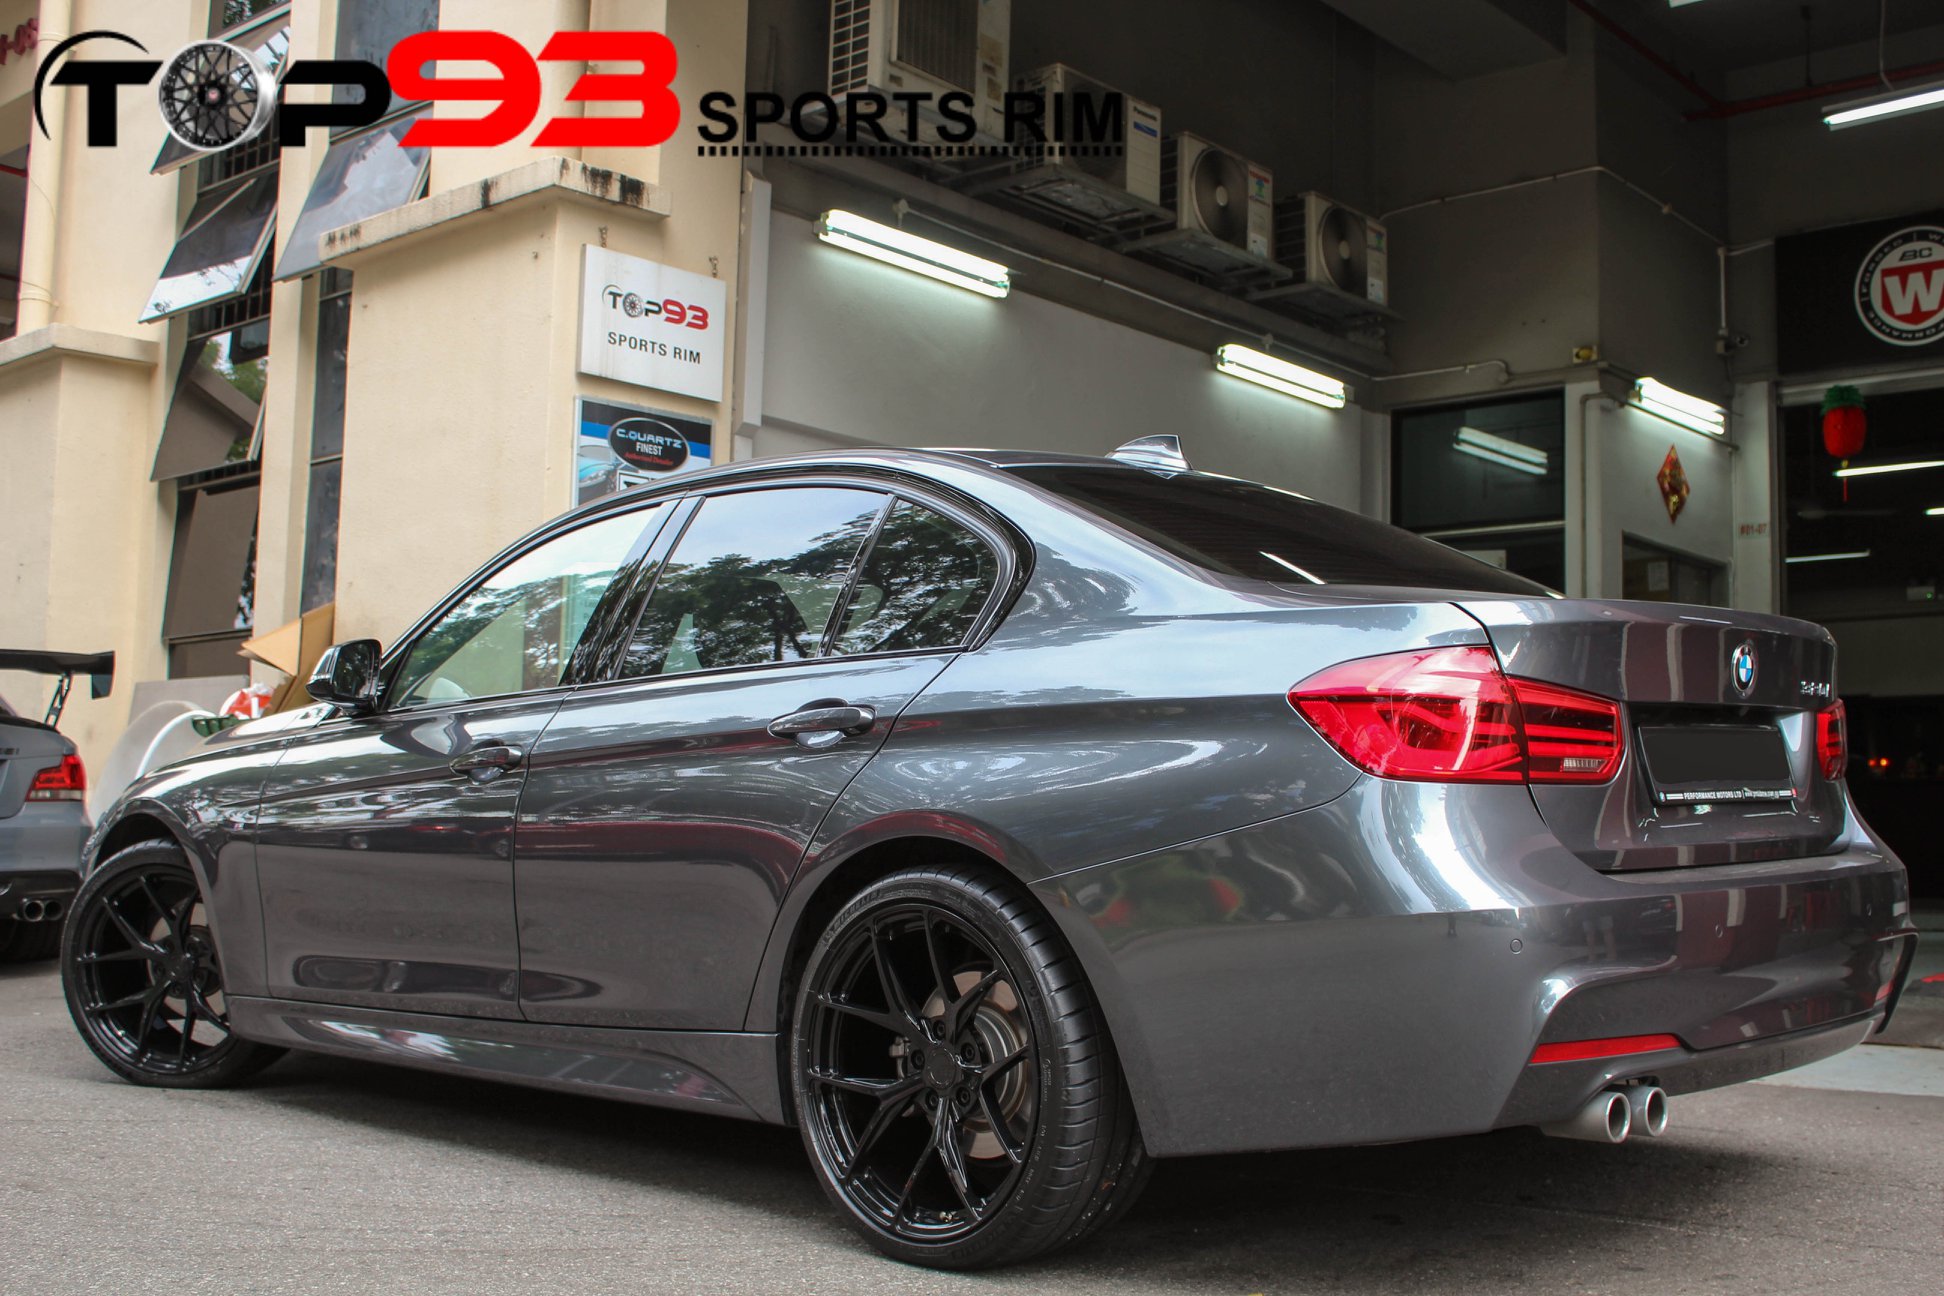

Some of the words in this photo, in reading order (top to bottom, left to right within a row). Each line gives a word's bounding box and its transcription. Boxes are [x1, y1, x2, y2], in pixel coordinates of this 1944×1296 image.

[607, 331, 667, 357] SPORTS
[673, 347, 701, 364] RIM
[616, 428, 682, 449] C.QUARTZ
[636, 441, 663, 456] FINEST
[1683, 791, 1716, 800] PERFORMANCE
[1716, 791, 1733, 799] MOTORS
